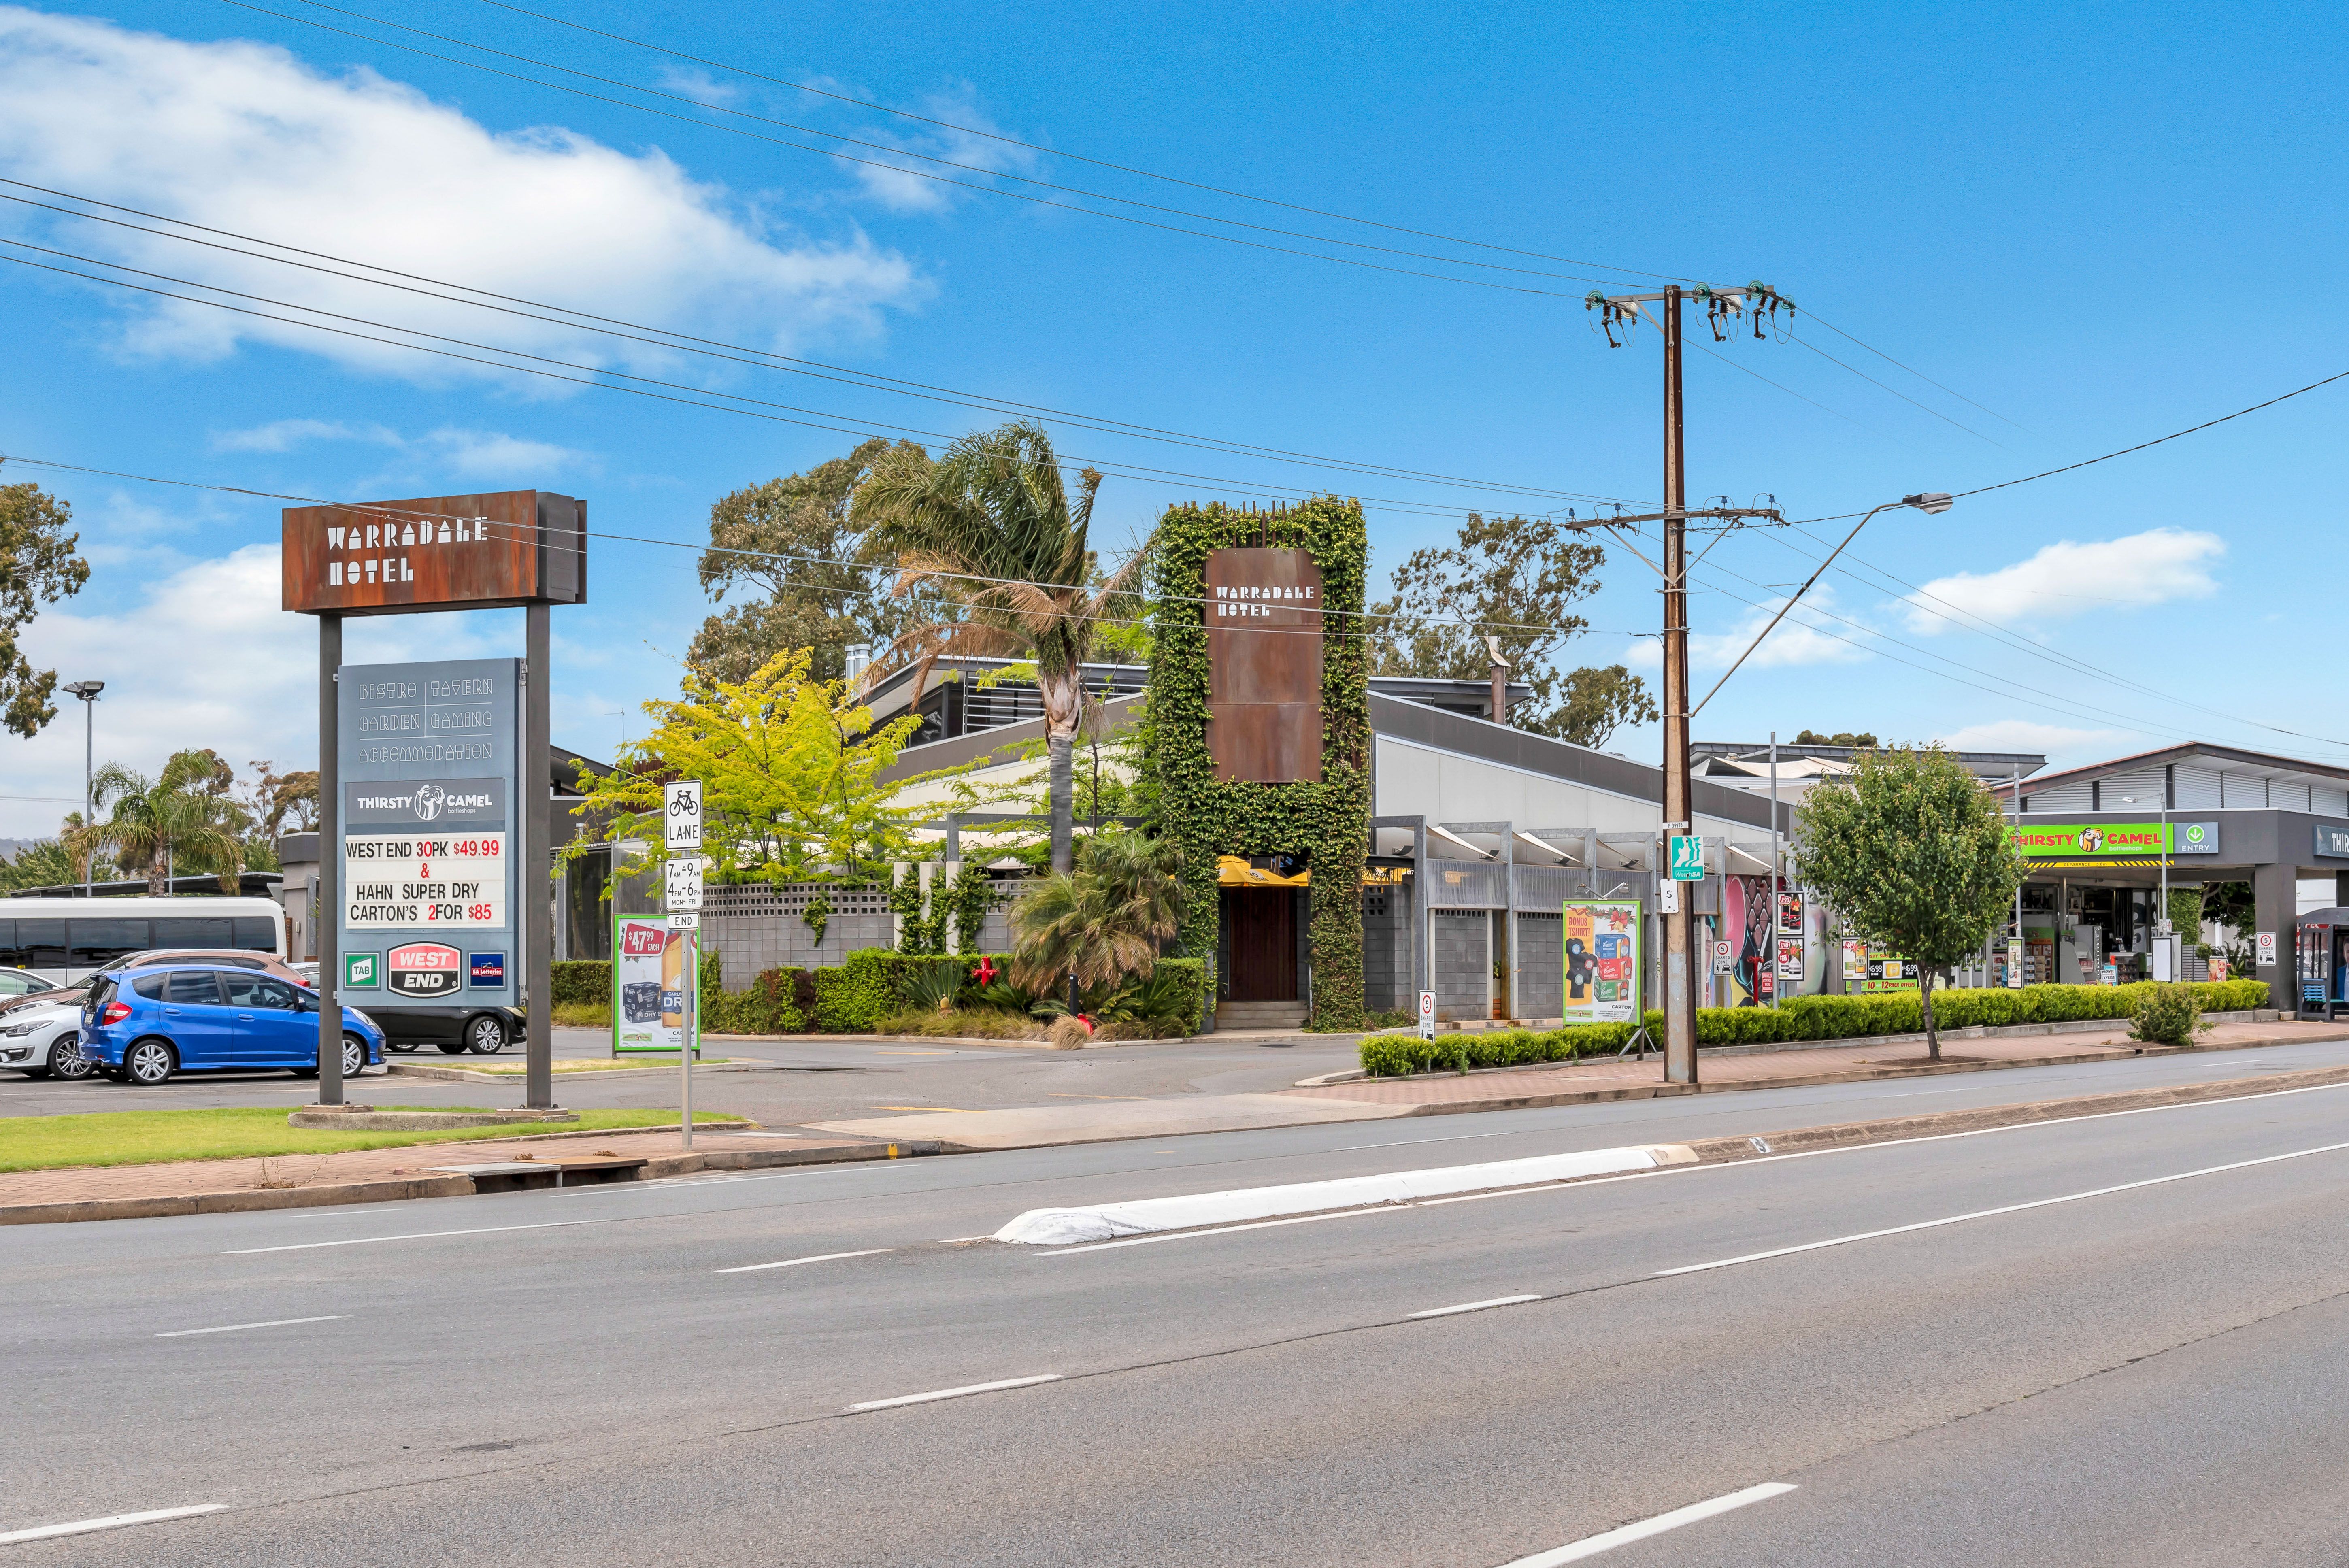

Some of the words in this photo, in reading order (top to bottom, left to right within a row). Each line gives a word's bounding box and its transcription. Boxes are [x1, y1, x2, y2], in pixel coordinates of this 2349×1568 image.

[328, 516, 488, 550] WARRADALE
[330, 557, 413, 586] HOTEL
[1216, 586, 1314, 599] WARRADALE
[1218, 604, 1270, 616] HOTEL
[359, 682, 417, 700] BISTRO
[430, 679, 492, 697] TAVERN
[359, 714, 420, 731] GARDEN
[430, 711, 492, 729] GAMING
[359, 743, 492, 763] ACCOMMODATION
[357, 796, 413, 809] THIRSTY
[447, 794, 493, 807] CAMEL
[670, 825, 698, 840] LANE
[2107, 832, 2162, 845] CAMEL
[346, 843, 383, 858] WEST
[386, 842, 411, 857] END
[417, 841, 448, 857] 30PK
[453, 840, 499, 857] $49.99
[421, 863, 430, 878] &
[357, 885, 393, 900] HAHN
[402, 883, 445, 899] SUPER
[452, 883, 479, 898] DRY
[350, 904, 417, 921] CARTON'S
[468, 904, 492, 919] $85
[675, 917, 692, 926] END
[1569, 917, 1587, 926] BONUS
[1568, 927, 1590, 937] TSHIRT!
[400, 952, 450, 966] WEST
[354, 966, 369, 974] TAB
[404, 974, 443, 987] END
[664, 997, 682, 1007] DR
[1426, 1000, 1428, 1008] 5
